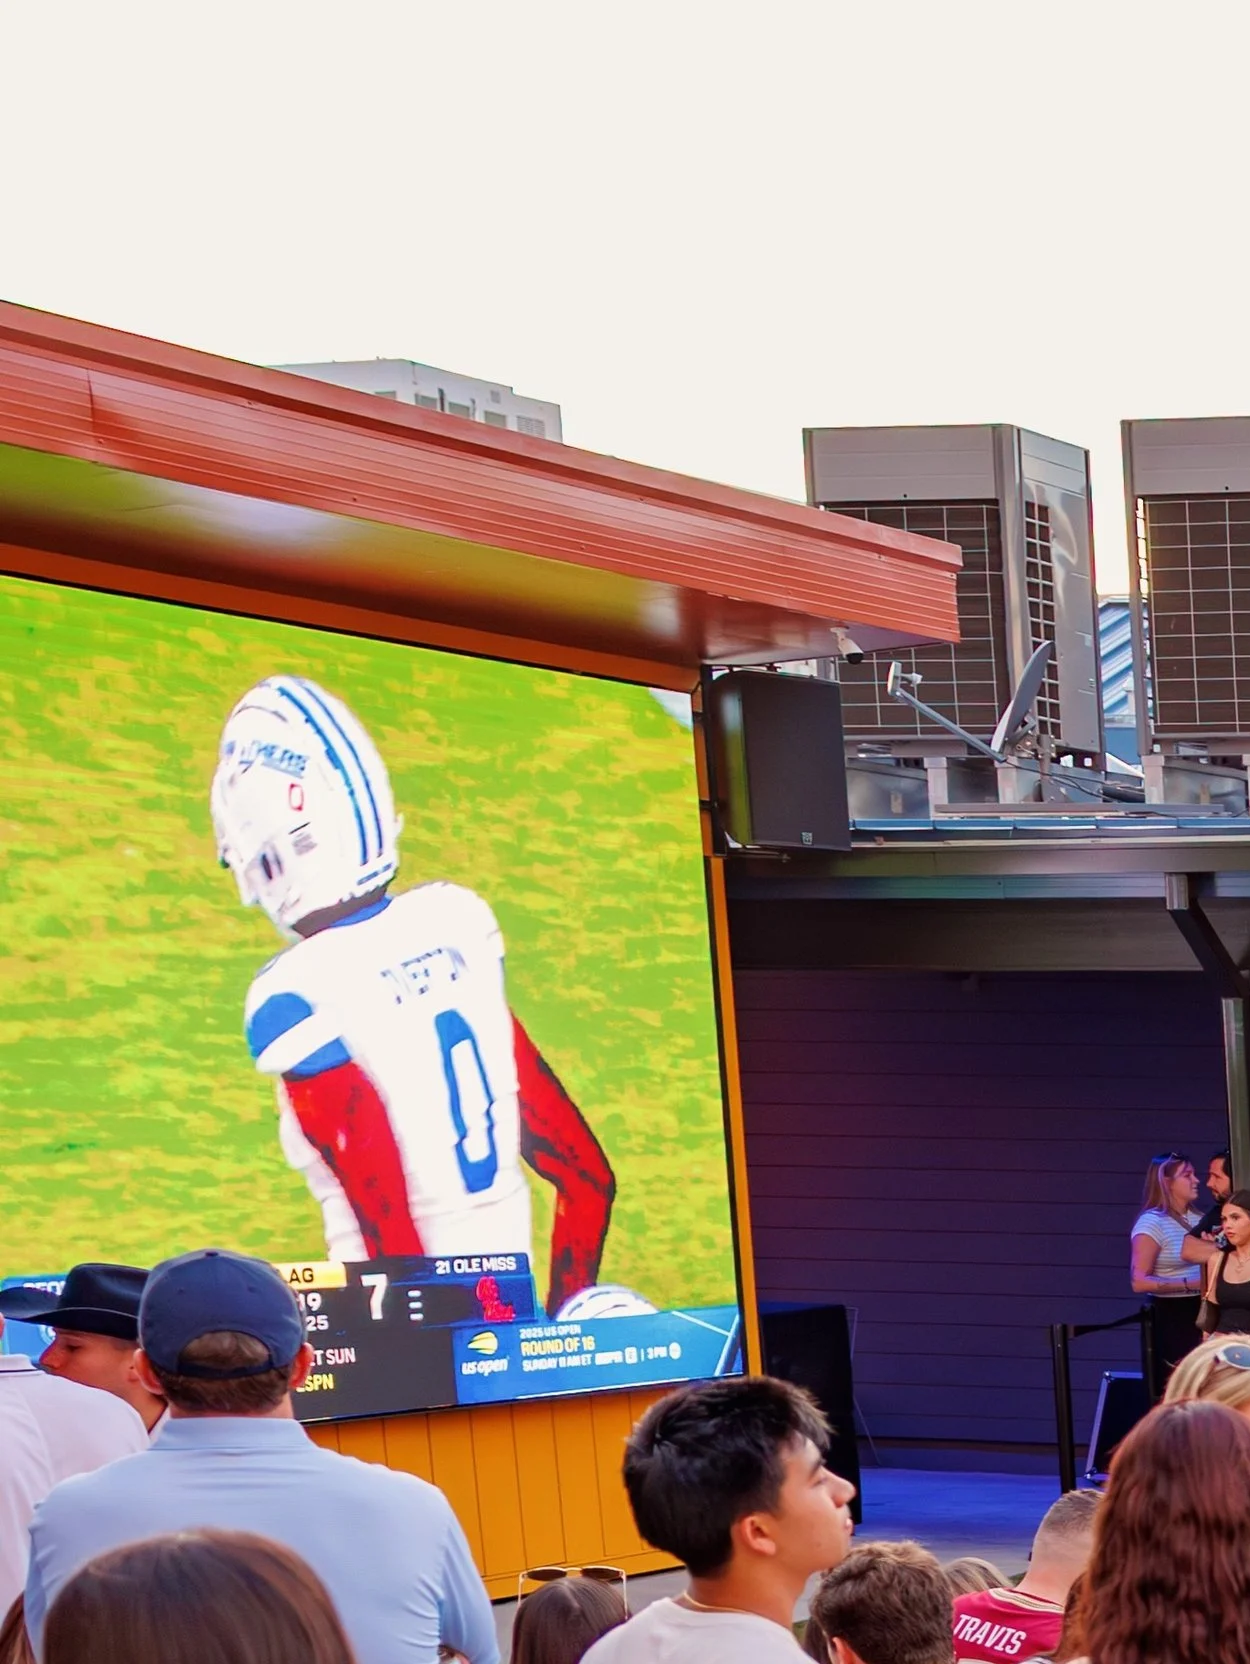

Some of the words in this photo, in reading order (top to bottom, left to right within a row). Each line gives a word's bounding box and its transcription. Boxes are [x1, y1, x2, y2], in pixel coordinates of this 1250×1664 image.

[289, 1267, 314, 1284] AG
[435, 1260, 450, 1275] 21
[453, 1257, 482, 1273] OLE
[482, 1256, 517, 1271] MISS
[360, 1273, 388, 1320] 7
[325, 1346, 356, 1366] SUN
[521, 1338, 564, 1357] ROUND
[564, 1336, 580, 1353] OF
[953, 1614, 1027, 1655] TRAVIS
